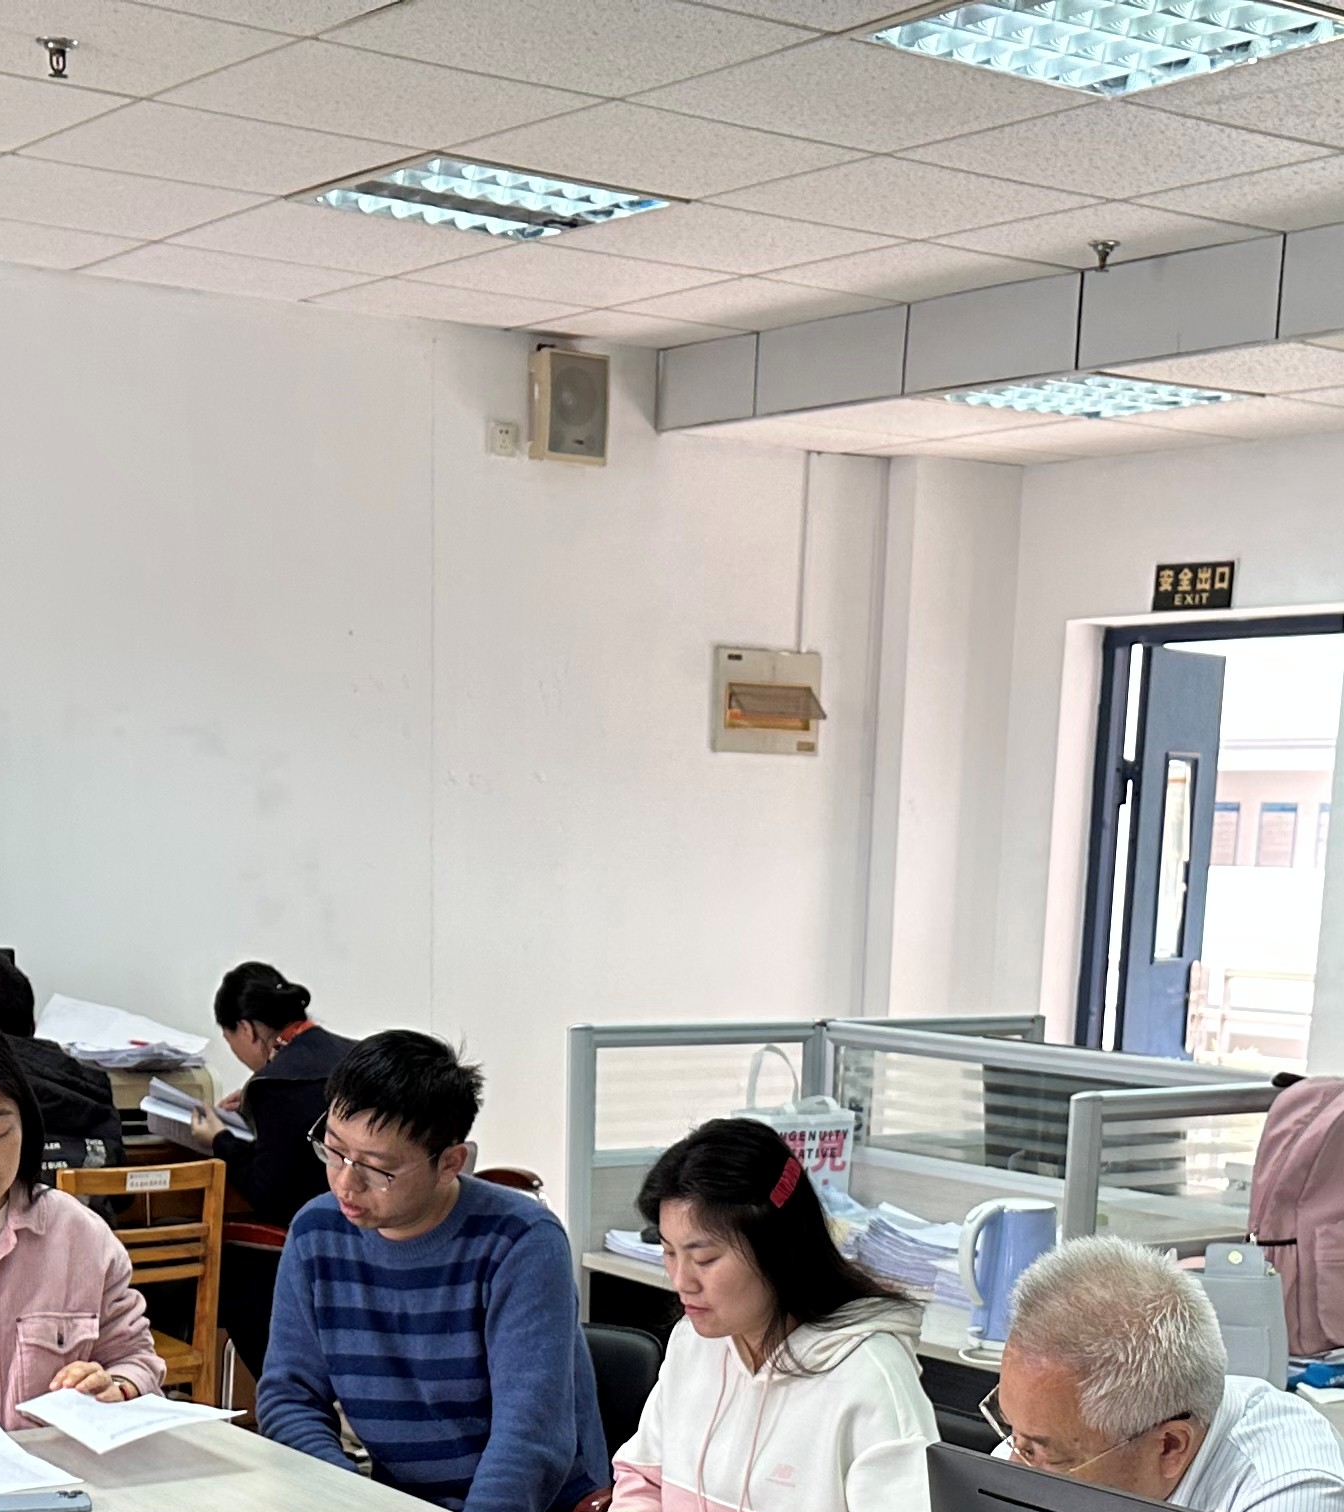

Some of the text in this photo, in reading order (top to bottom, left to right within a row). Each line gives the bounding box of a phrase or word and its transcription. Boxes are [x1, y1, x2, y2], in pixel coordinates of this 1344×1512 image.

[1158, 566, 1230, 592] 安全出口
[1173, 592, 1209, 606] EXIT
